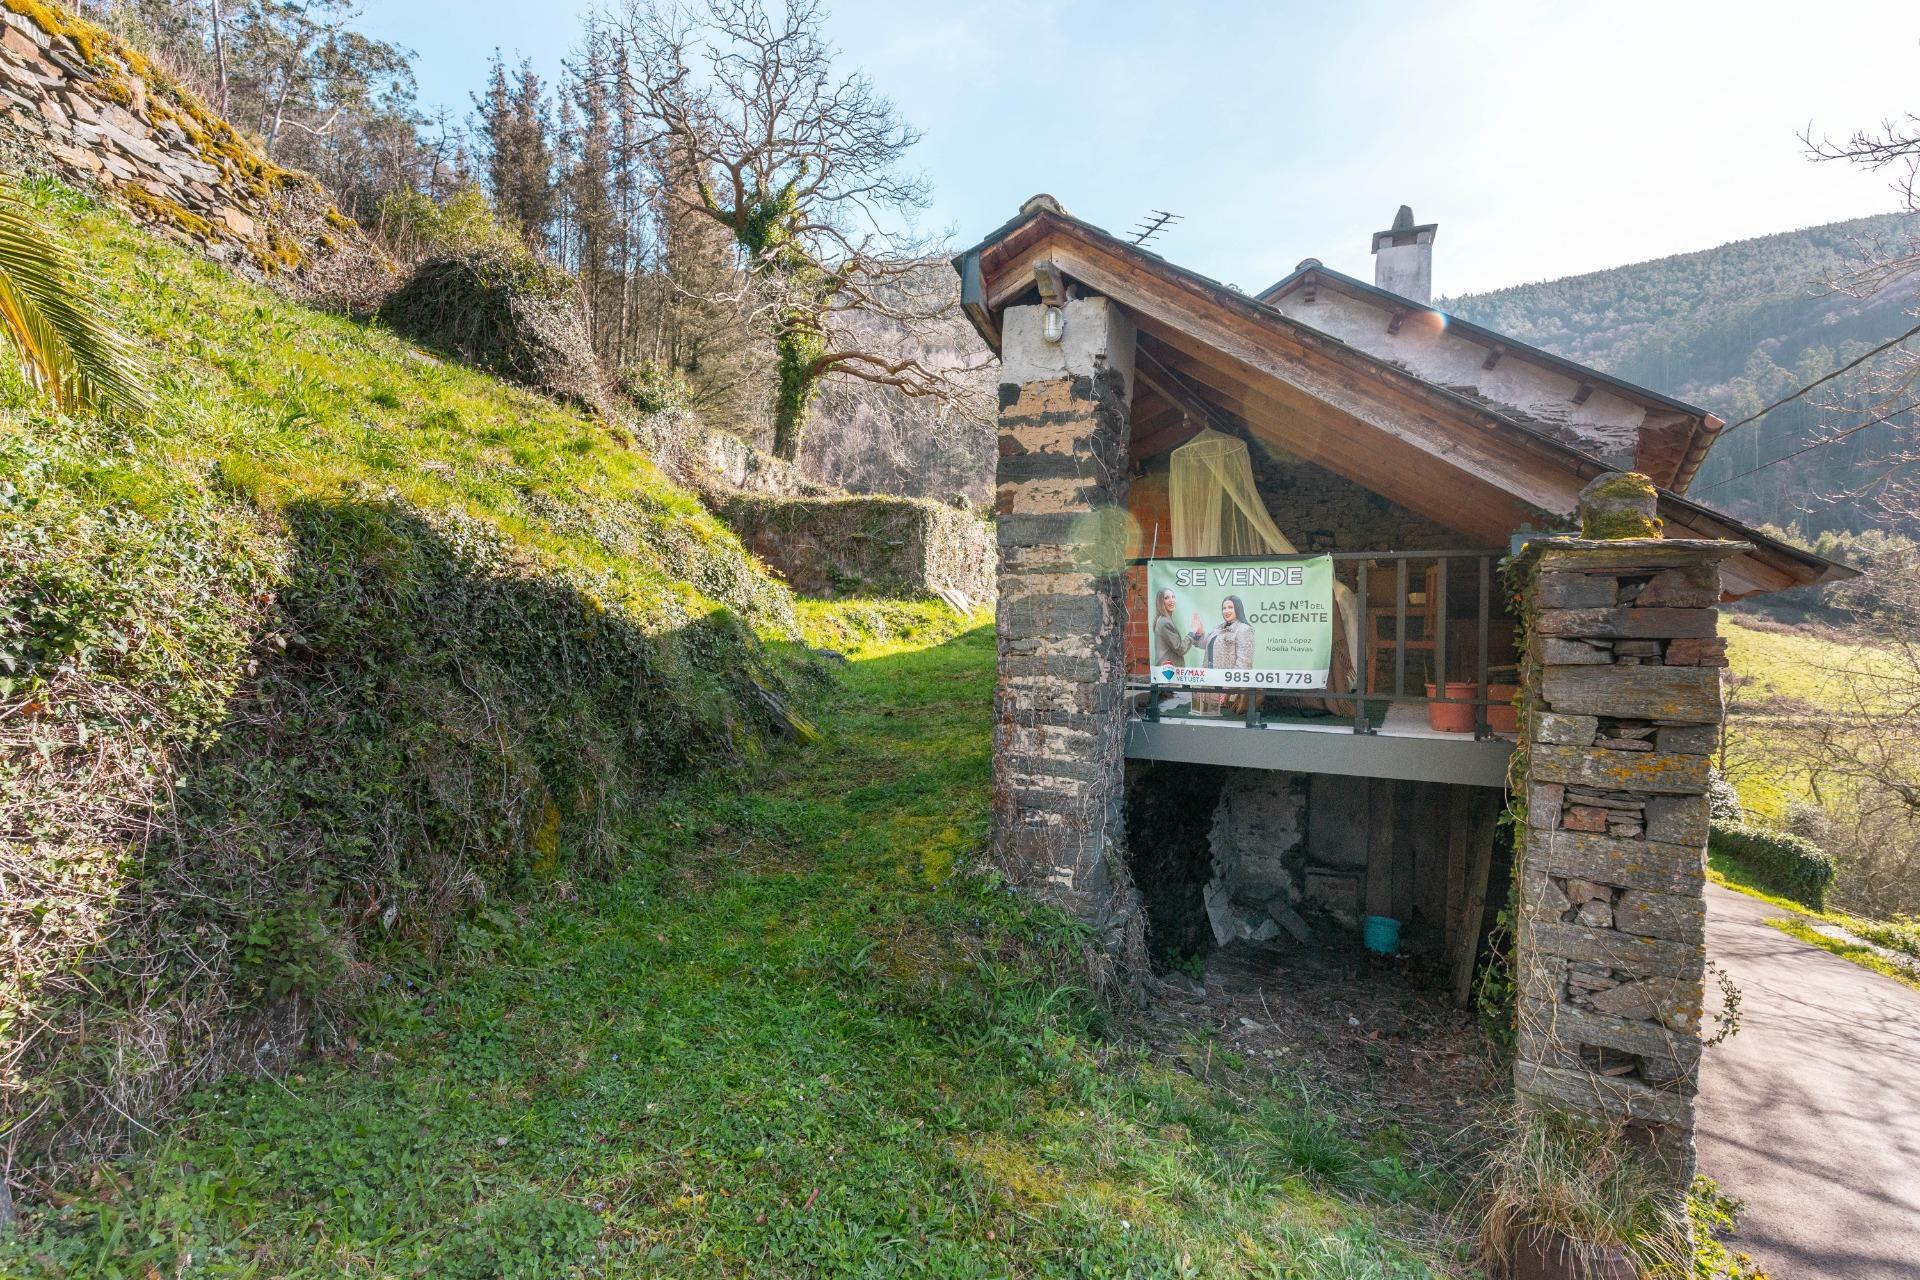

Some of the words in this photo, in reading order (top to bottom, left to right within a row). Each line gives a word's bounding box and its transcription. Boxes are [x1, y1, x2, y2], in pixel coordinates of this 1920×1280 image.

[1176, 568, 1207, 586] SE
[1213, 566, 1303, 586] VENDE
[1260, 601, 1286, 611] LAS
[1249, 612, 1328, 623] OCCIDENTE
[1175, 669, 1205, 677] RE/MAX
[1224, 671, 1250, 682] 985
[1255, 672, 1280, 684] 061
[1285, 673, 1313, 684] 778
